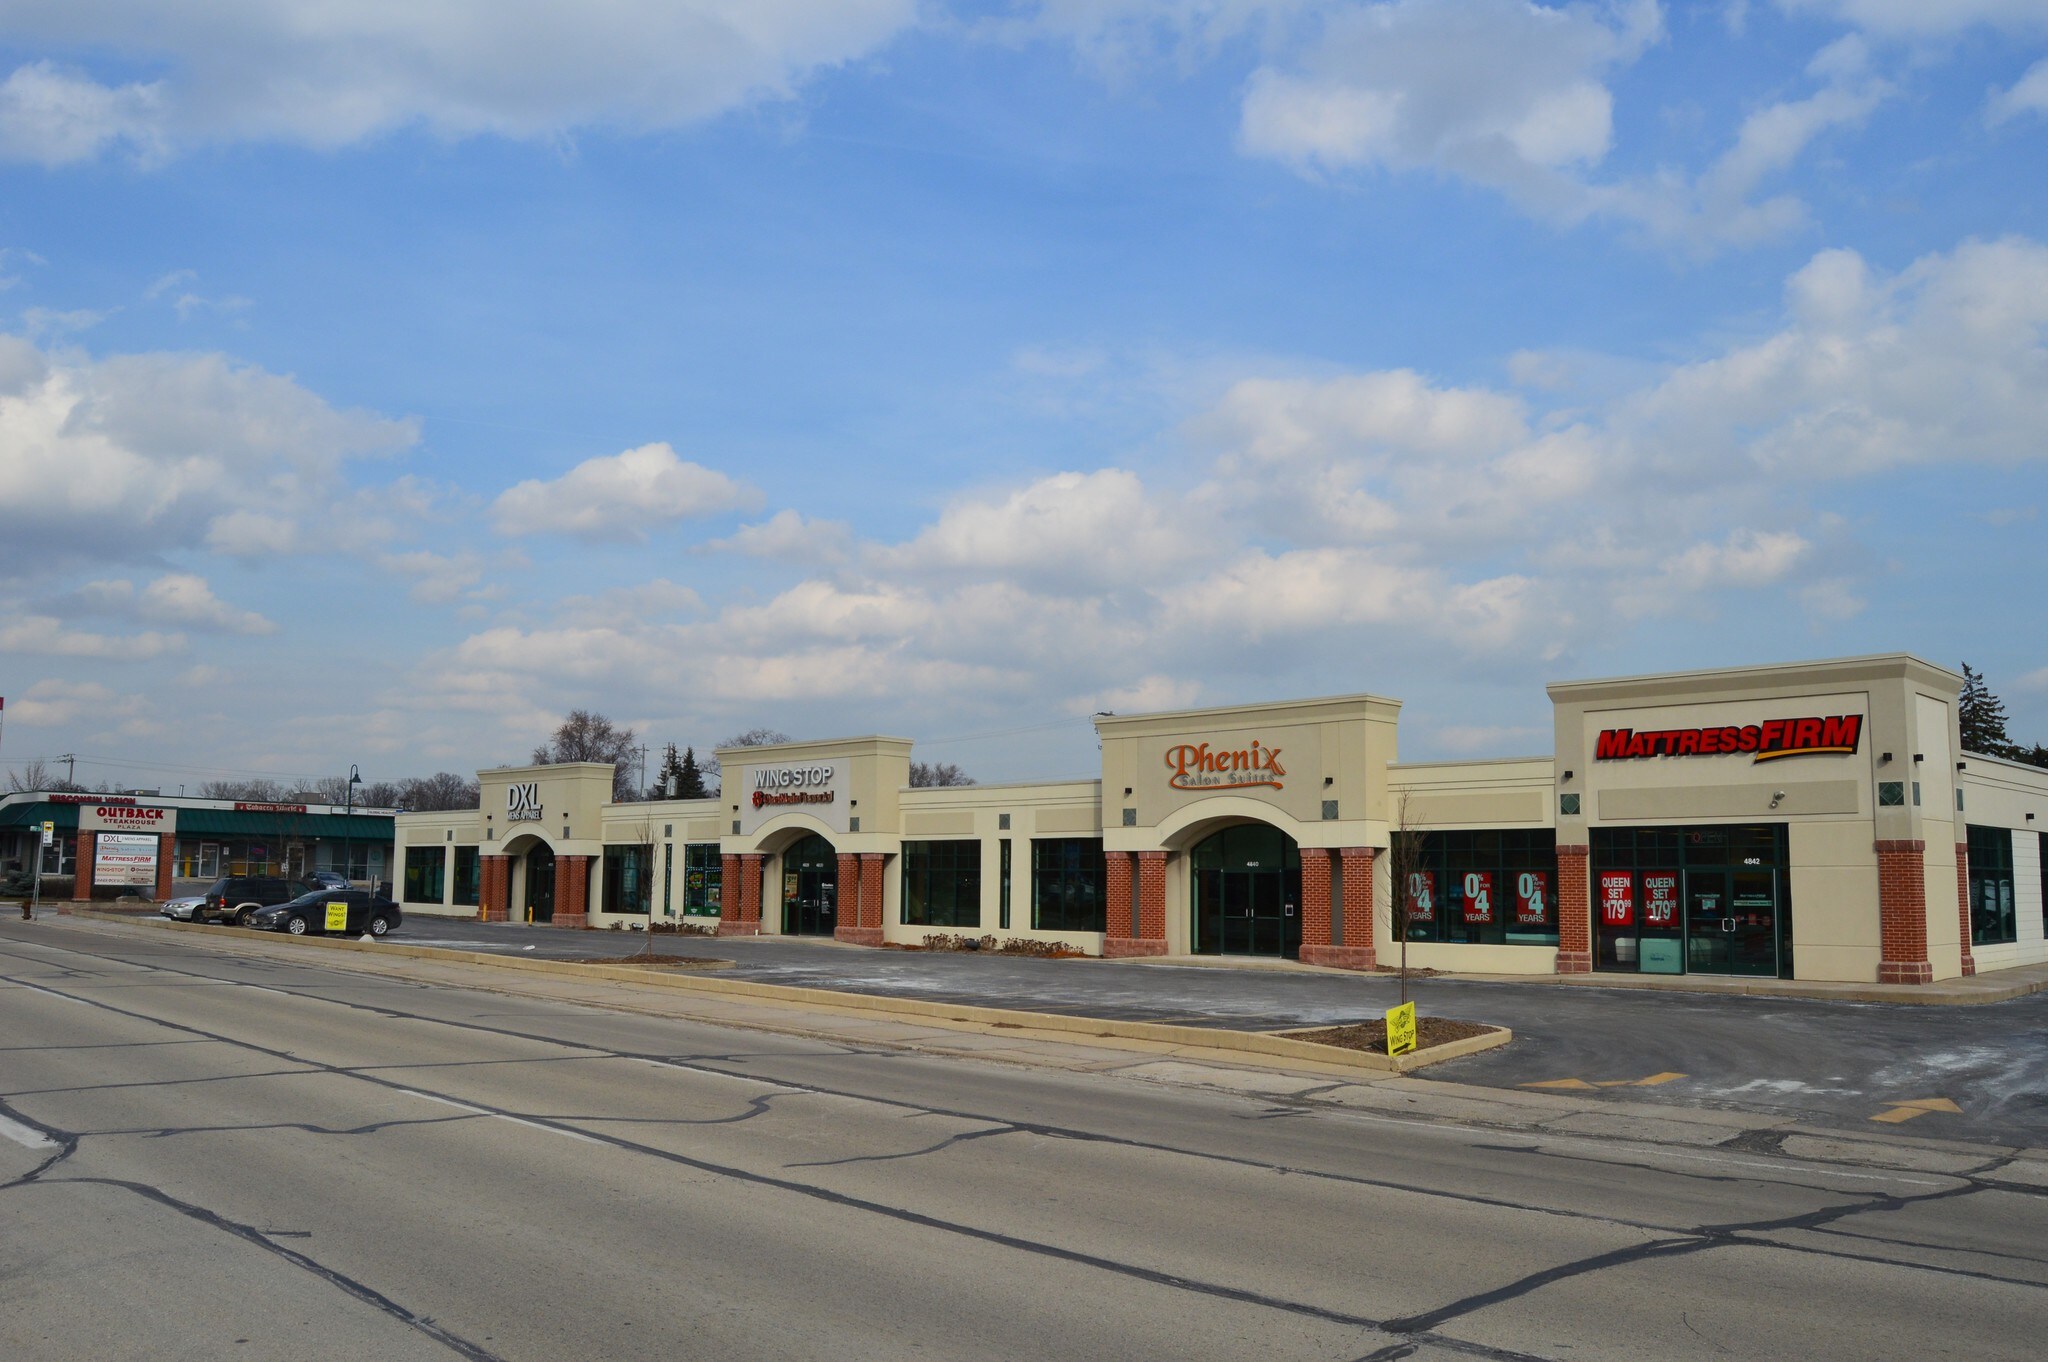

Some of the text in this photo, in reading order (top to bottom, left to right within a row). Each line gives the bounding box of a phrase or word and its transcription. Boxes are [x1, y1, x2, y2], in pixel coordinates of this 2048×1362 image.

[1165, 740, 1287, 778] Phenix
[754, 766, 833, 788] WING STOP
[48, 794, 136, 805] WISCONSIN VISION
[508, 783, 544, 811] DXL
[96, 807, 164, 819] OUTBACK
[103, 818, 156, 826] STEAKHOUSE
[103, 835, 122, 843] DXL
[1743, 857, 1761, 865] 4842
[1602, 877, 1631, 888] QUEEN
[1645, 877, 1675, 889] QUEEN
[1608, 888, 1625, 899] SET
[1652, 889, 1669, 900] SET
[1417, 889, 1432, 912] 4
[1474, 890, 1490, 914] 4
[1528, 890, 1544, 914] 4
[1409, 911, 1432, 920] YEARS
[1465, 913, 1490, 921] YEARS
[1519, 914, 1545, 923] YEARS
[1389, 1029, 1415, 1047] WING STOP
